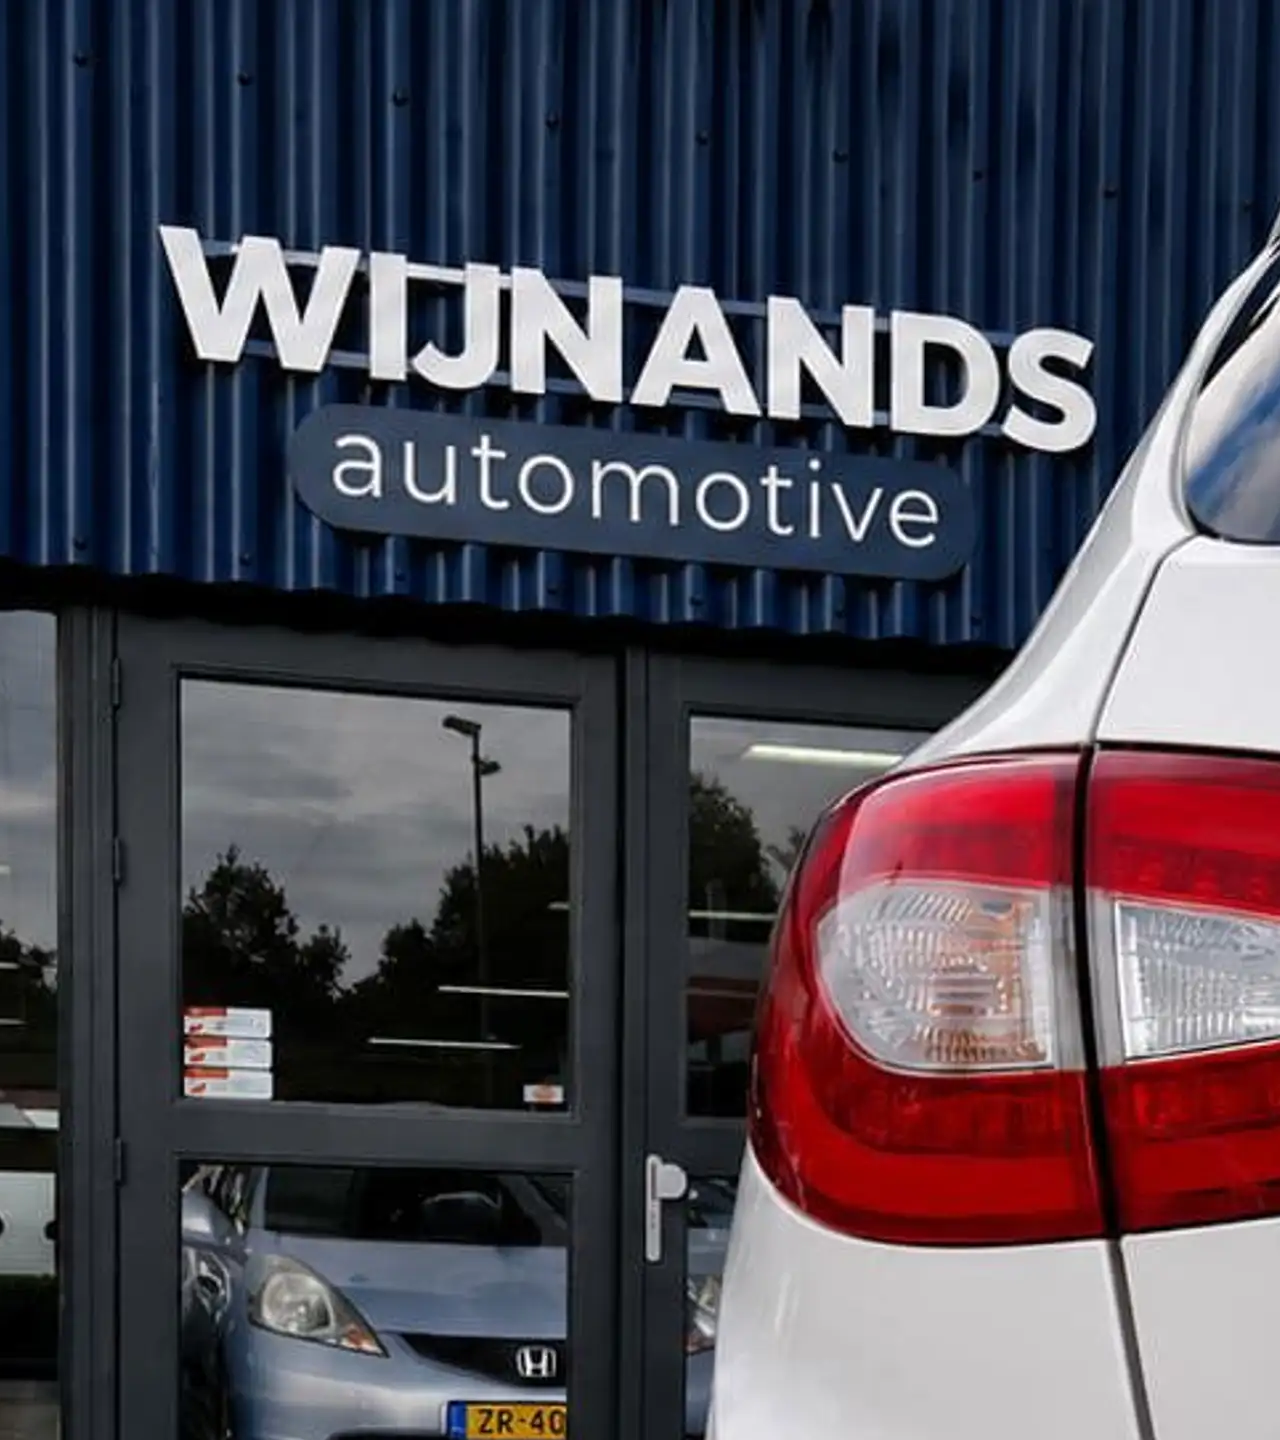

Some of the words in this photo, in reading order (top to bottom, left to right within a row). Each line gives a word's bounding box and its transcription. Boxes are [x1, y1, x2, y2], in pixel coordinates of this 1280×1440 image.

[159, 225, 1098, 453] WIJNANDS
[331, 432, 940, 547] automotive
[477, 1408, 566, 1435] ZR-40
